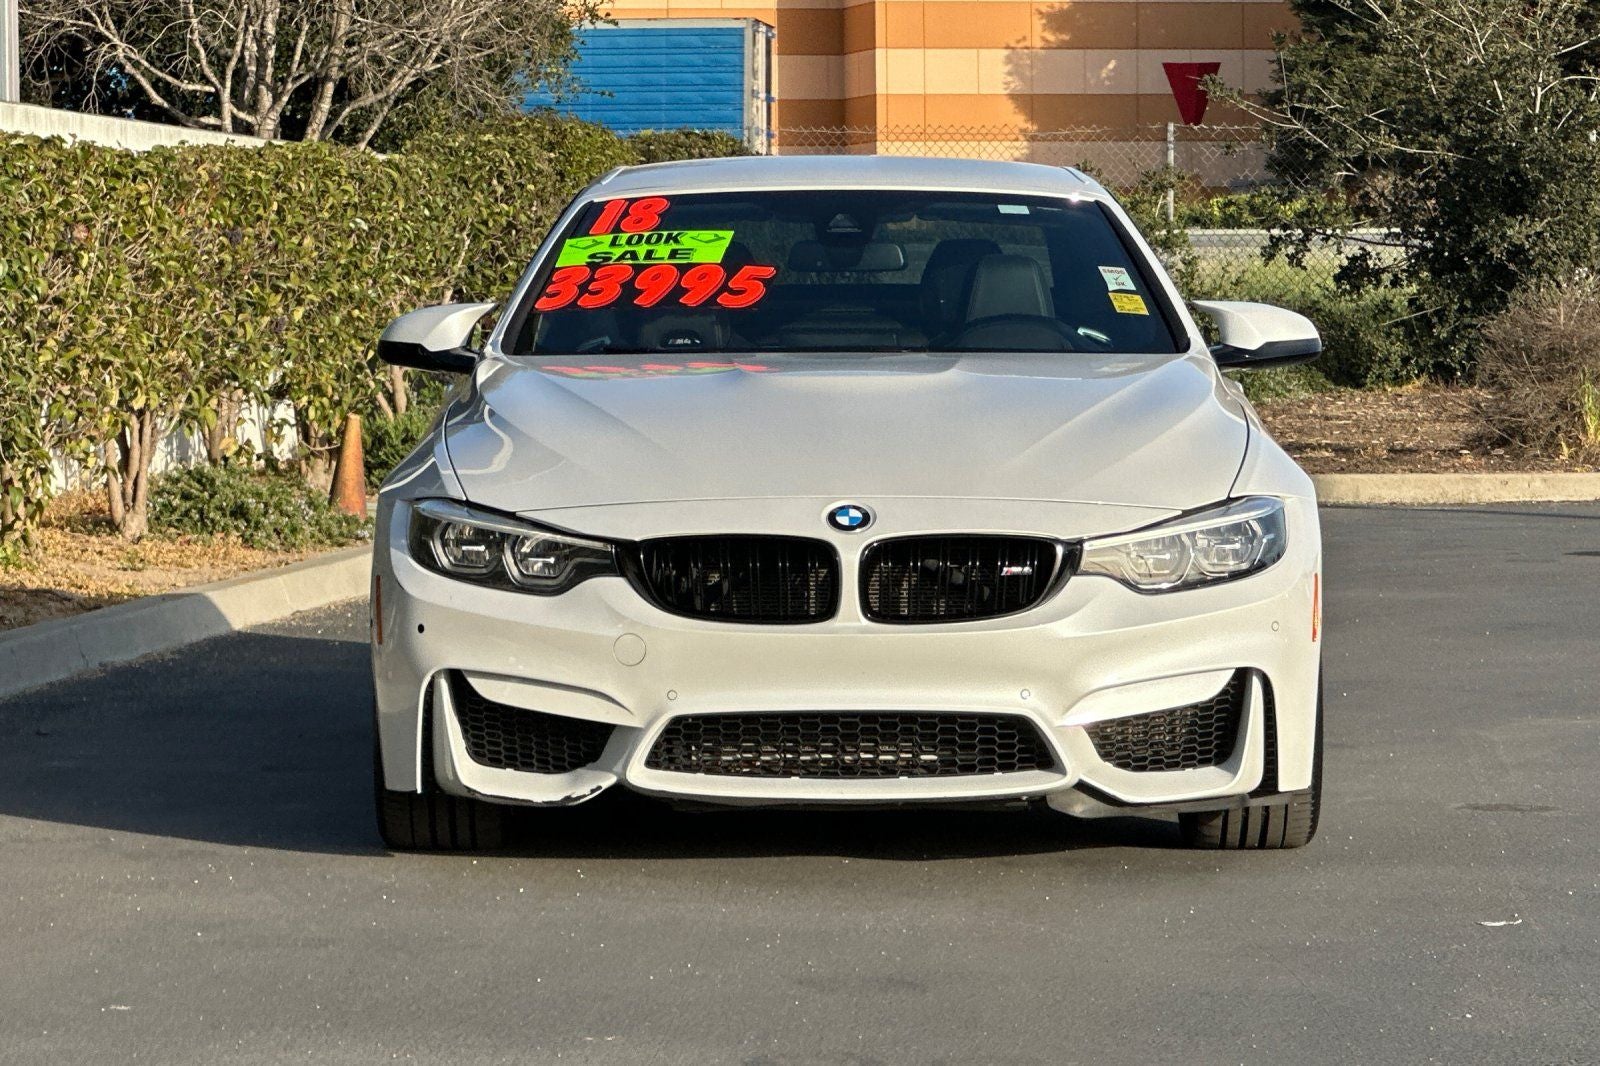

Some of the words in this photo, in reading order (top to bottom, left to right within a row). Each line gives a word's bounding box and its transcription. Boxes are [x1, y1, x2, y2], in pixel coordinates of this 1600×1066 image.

[589, 195, 670, 235] 18
[608, 231, 688, 248] LOOK
[585, 247, 696, 265] SALE
[534, 264, 777, 311] 33995
